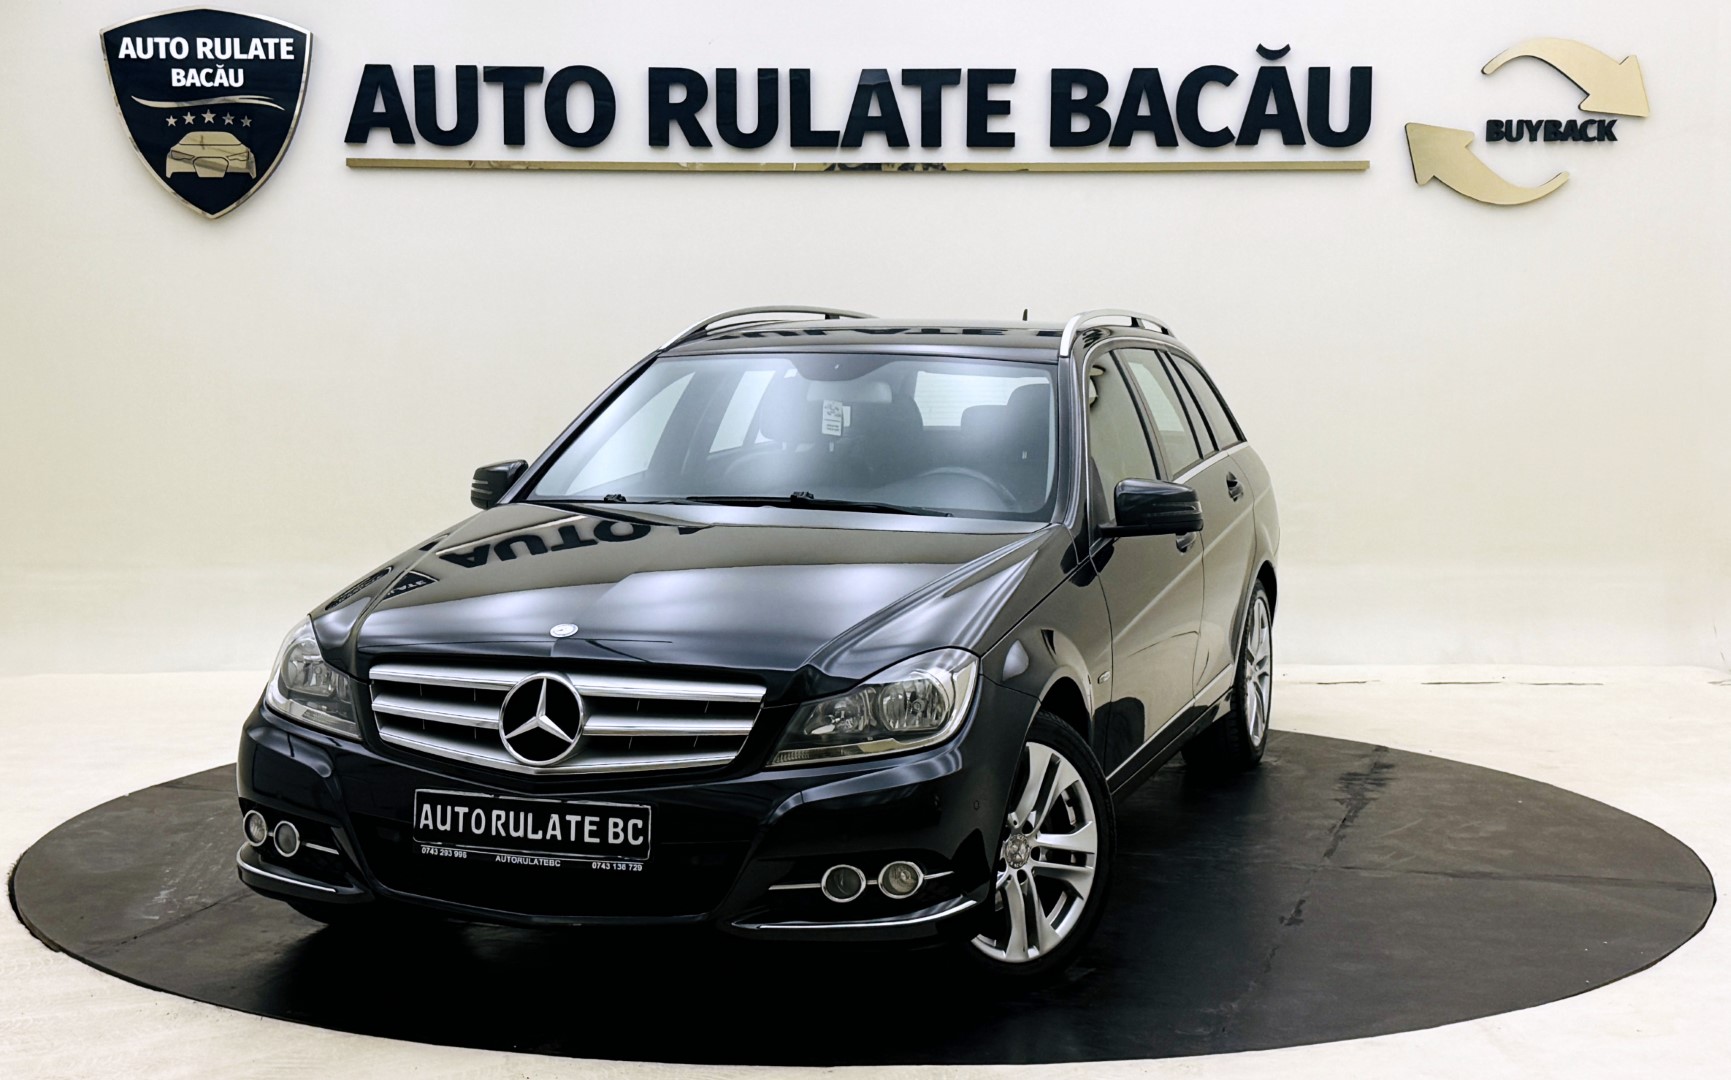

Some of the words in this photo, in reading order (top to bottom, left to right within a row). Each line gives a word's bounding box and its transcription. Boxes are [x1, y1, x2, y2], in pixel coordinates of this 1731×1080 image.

[118, 36, 190, 60] AUTO
[196, 37, 295, 60] RULATE
[171, 63, 244, 88] BACĂU
[344, 63, 616, 148] AUTO
[648, 66, 1017, 150] RULATE
[1049, 43, 1373, 149] BACĂU
[1485, 118, 1619, 143] BUYBACK
[607, 817, 644, 846] BC
[421, 847, 439, 856] 0743
[495, 855, 562, 867] AUTORULATEBC
[591, 861, 611, 870] 0743
